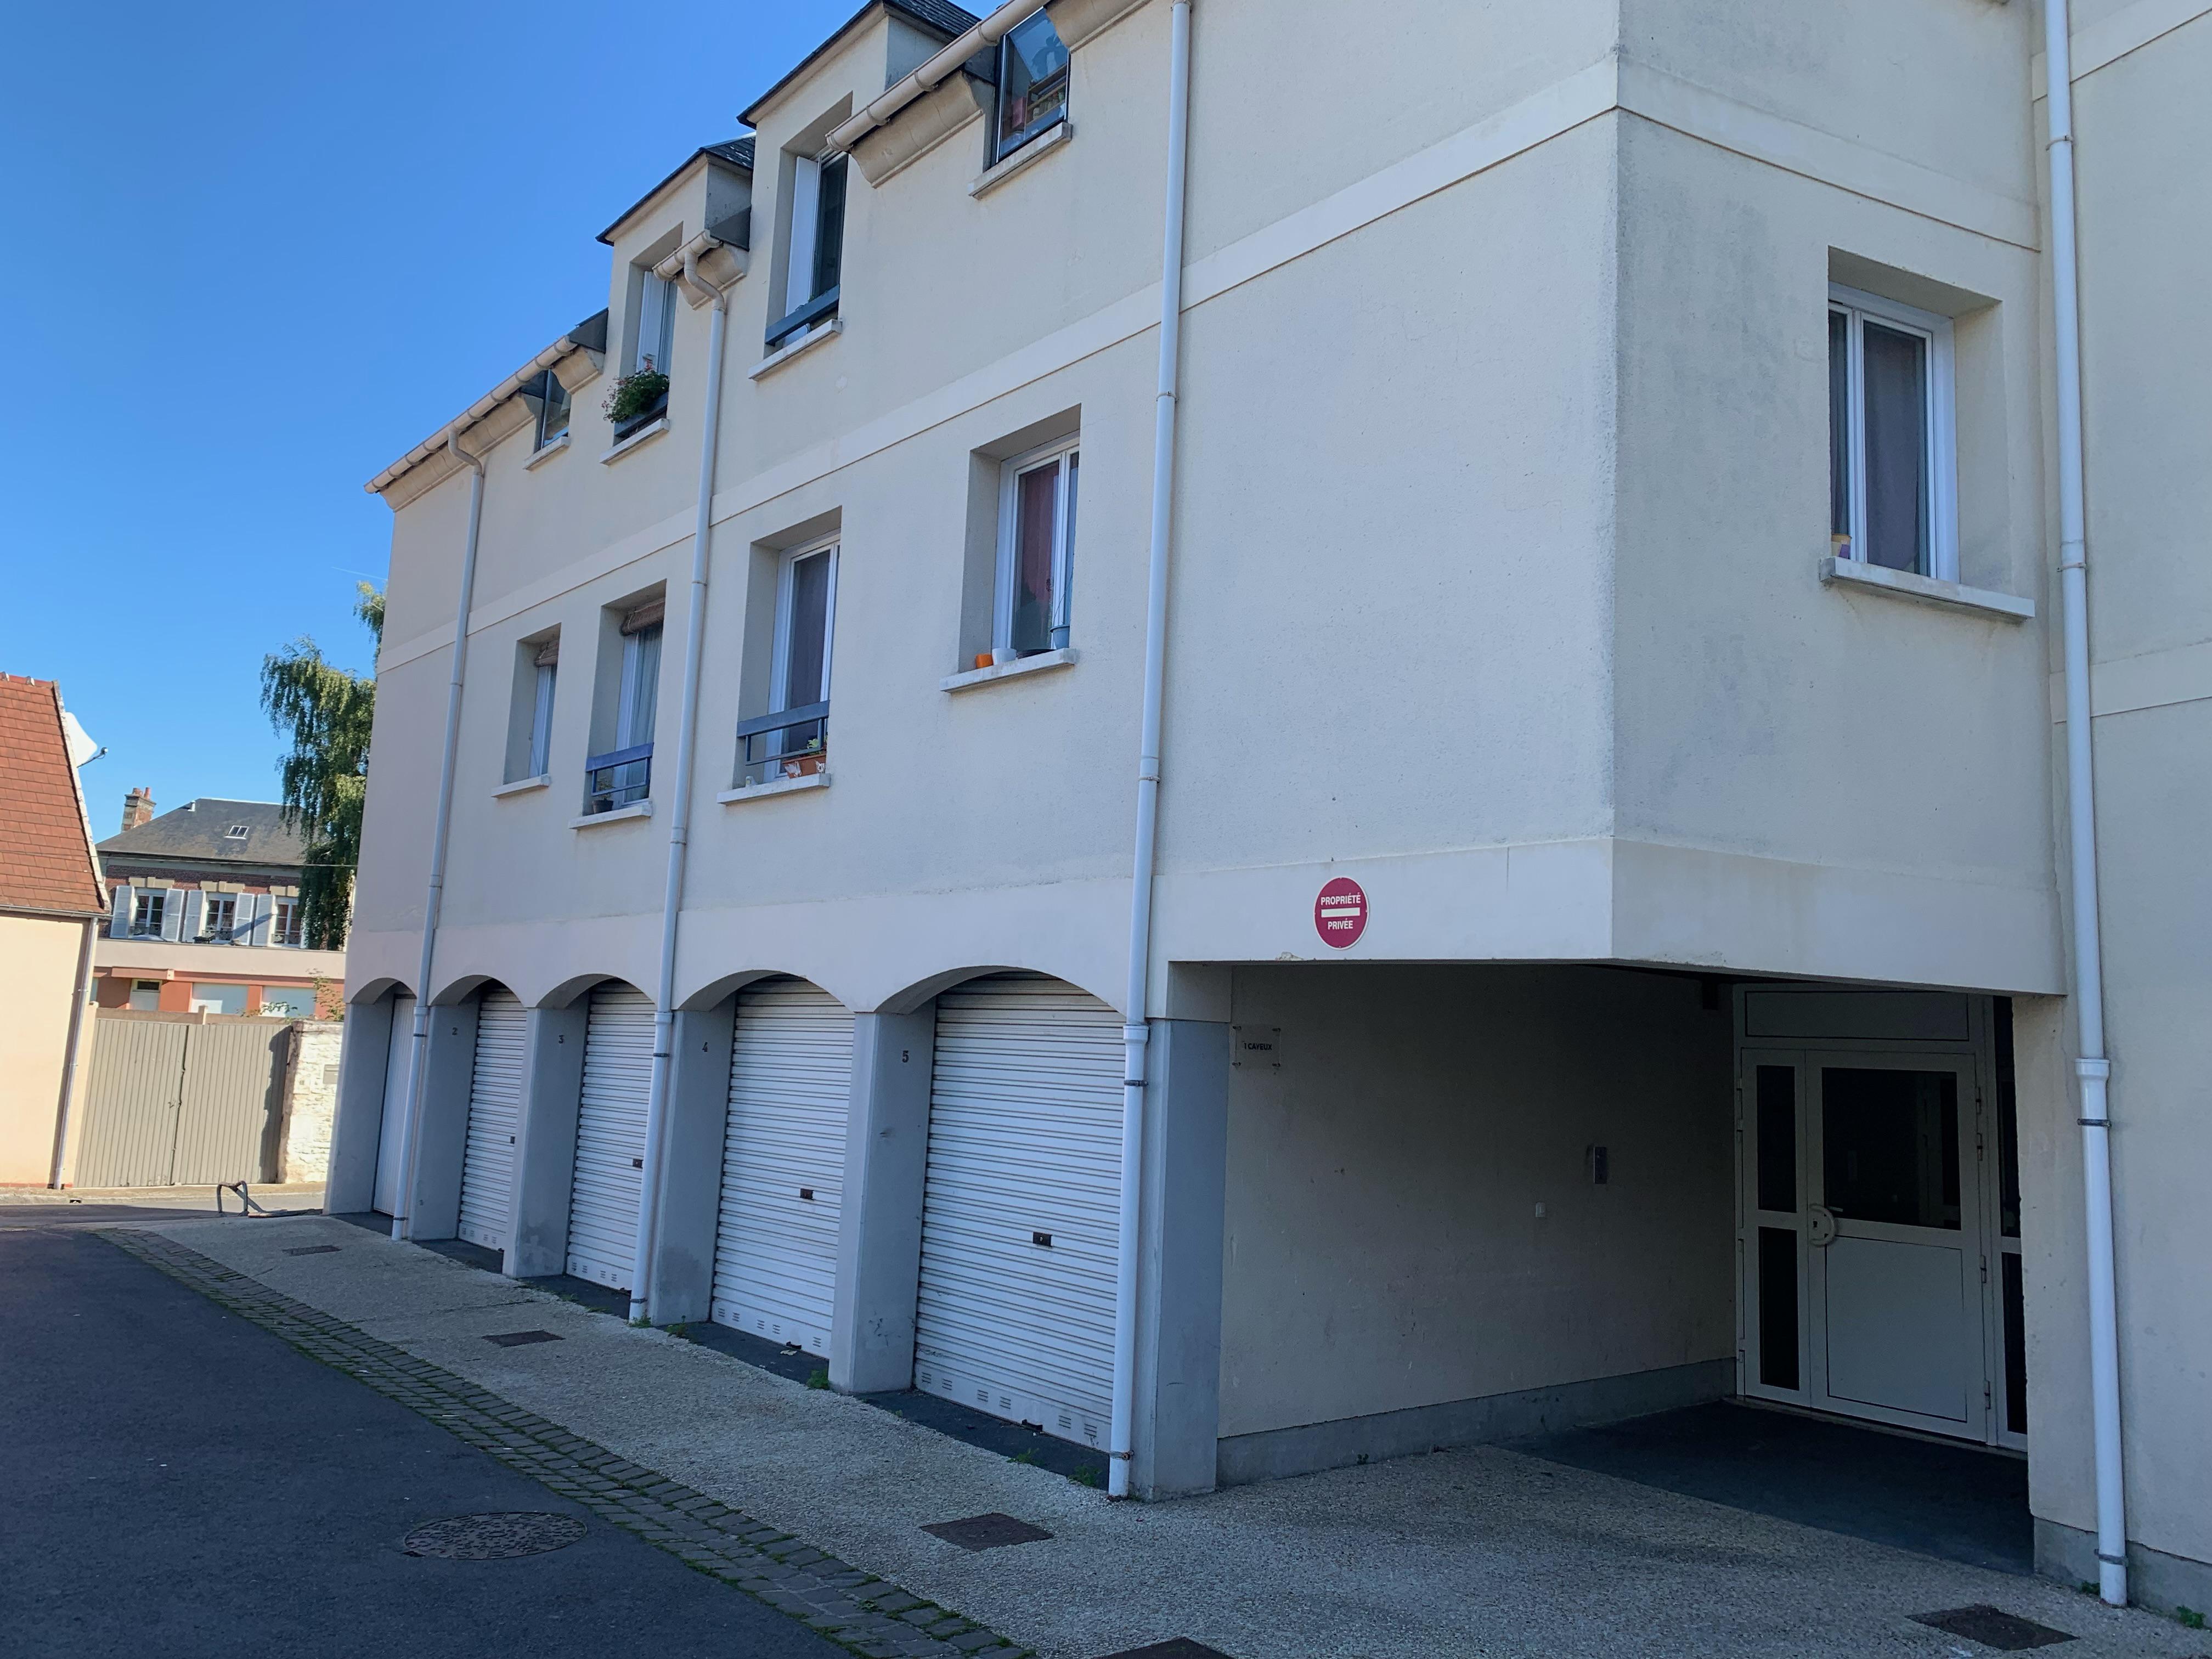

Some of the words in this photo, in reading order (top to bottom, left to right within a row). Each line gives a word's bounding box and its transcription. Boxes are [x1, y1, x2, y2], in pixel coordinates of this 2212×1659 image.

[1321, 893, 1361, 906] PROPRIÉTÉ
[1328, 918, 1353, 930] PRIVÉE
[452, 1027, 458, 1035] 2
[558, 1035, 564, 1043] 3
[702, 1042, 708, 1052] 4
[902, 1050, 909, 1063] 5
